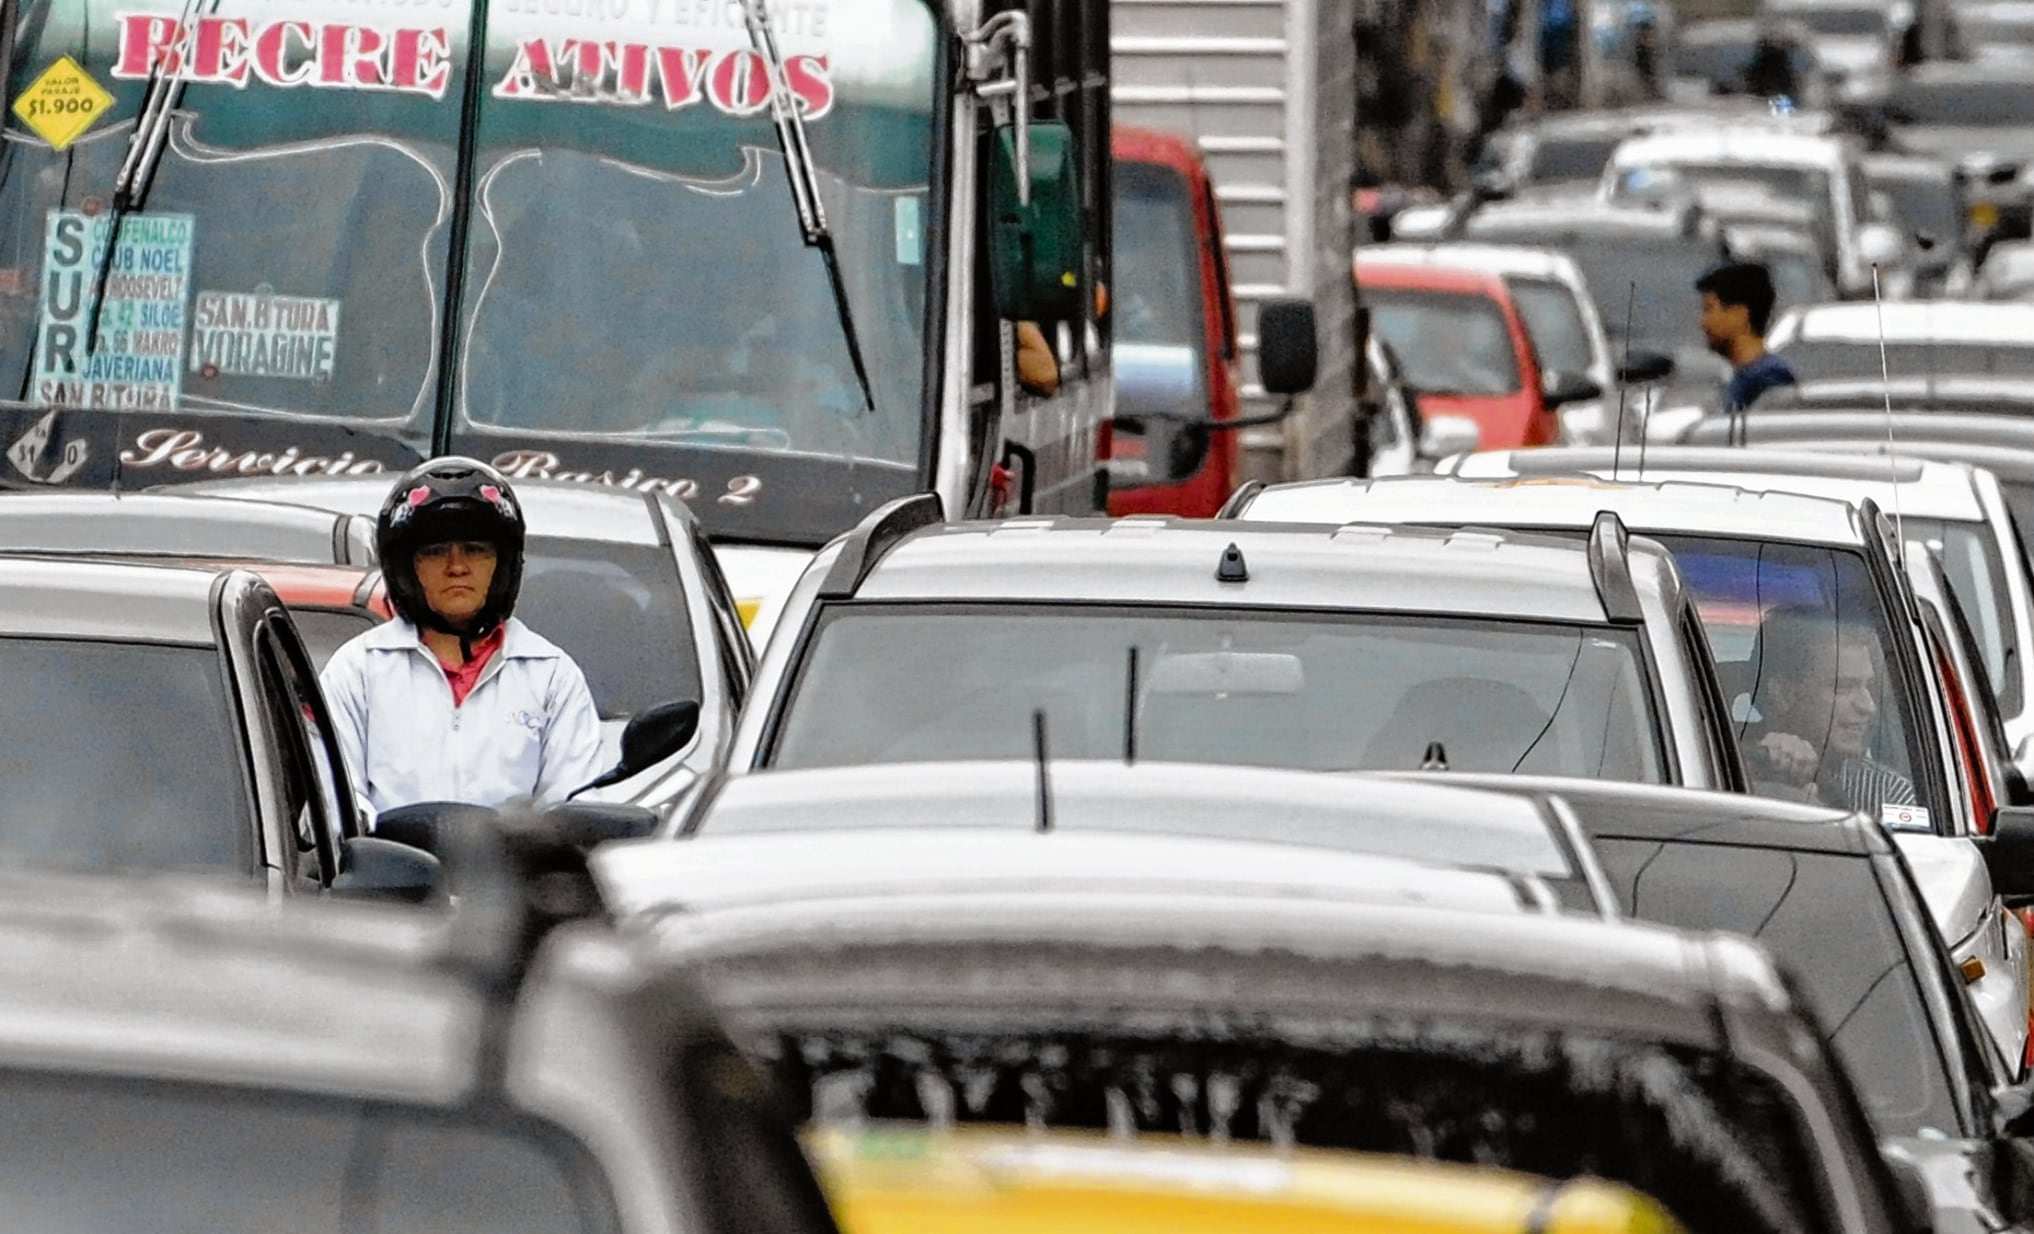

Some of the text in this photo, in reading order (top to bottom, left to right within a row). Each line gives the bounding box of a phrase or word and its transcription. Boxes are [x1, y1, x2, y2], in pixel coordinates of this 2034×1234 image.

[674, 0, 829, 37] EFICINTE
[492, 38, 834, 122] ATIVOS
[28, 98, 93, 119] $1.900
[93, 218, 187, 245] COFENALCO
[91, 246, 183, 273] CUB NOEL
[140, 303, 181, 328] SILOE
[194, 329, 332, 378] VORAGINE
[82, 355, 175, 384] JAVERIANA
[119, 428, 382, 476] Servicio
[718, 475, 762, 504] 2
